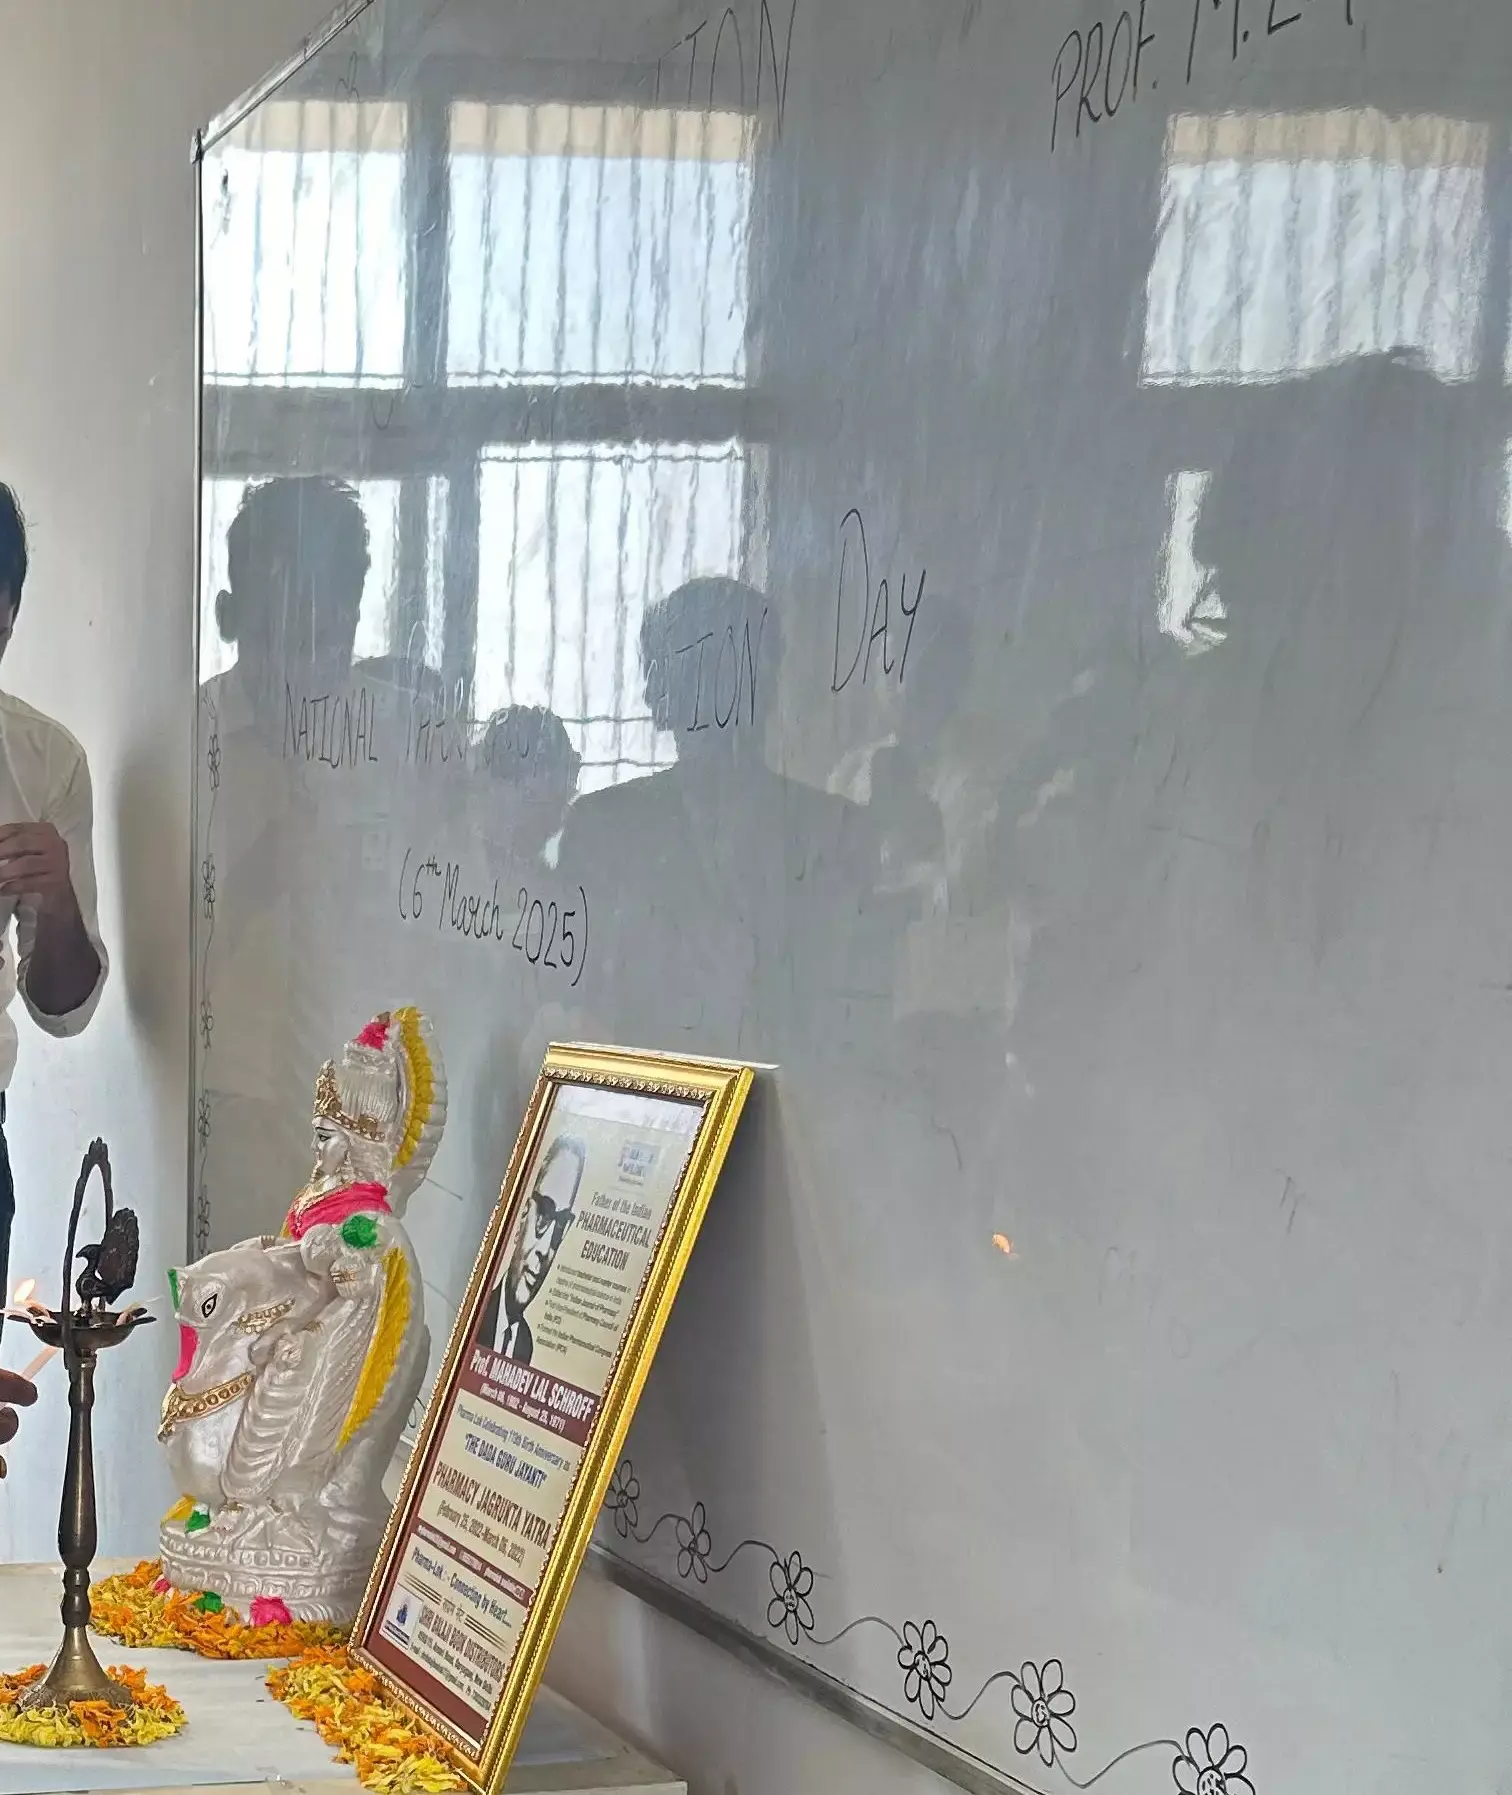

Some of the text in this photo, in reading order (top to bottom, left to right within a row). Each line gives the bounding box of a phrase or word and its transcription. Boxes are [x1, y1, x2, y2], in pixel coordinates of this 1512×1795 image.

[283, 682, 379, 769] NATIONAL
[439, 862, 504, 941] March
[511, 885, 588, 987] 2025)
[574, 1209, 654, 1248] PHARMACEUTICAL
[579, 1239, 630, 1271] EDUCATION
[469, 1349, 594, 1423] Prof. MAHADEV LAL SCHROFF
[476, 1439, 498, 1464] DADA
[494, 1449, 517, 1474] GURU
[432, 1460, 553, 1549] PHARMACY JAGRUKTA YATRA
[410, 1546, 445, 1579] Pharma-Lok
[448, 1571, 483, 1607] Connecting
[479, 1593, 490, 1613] by
